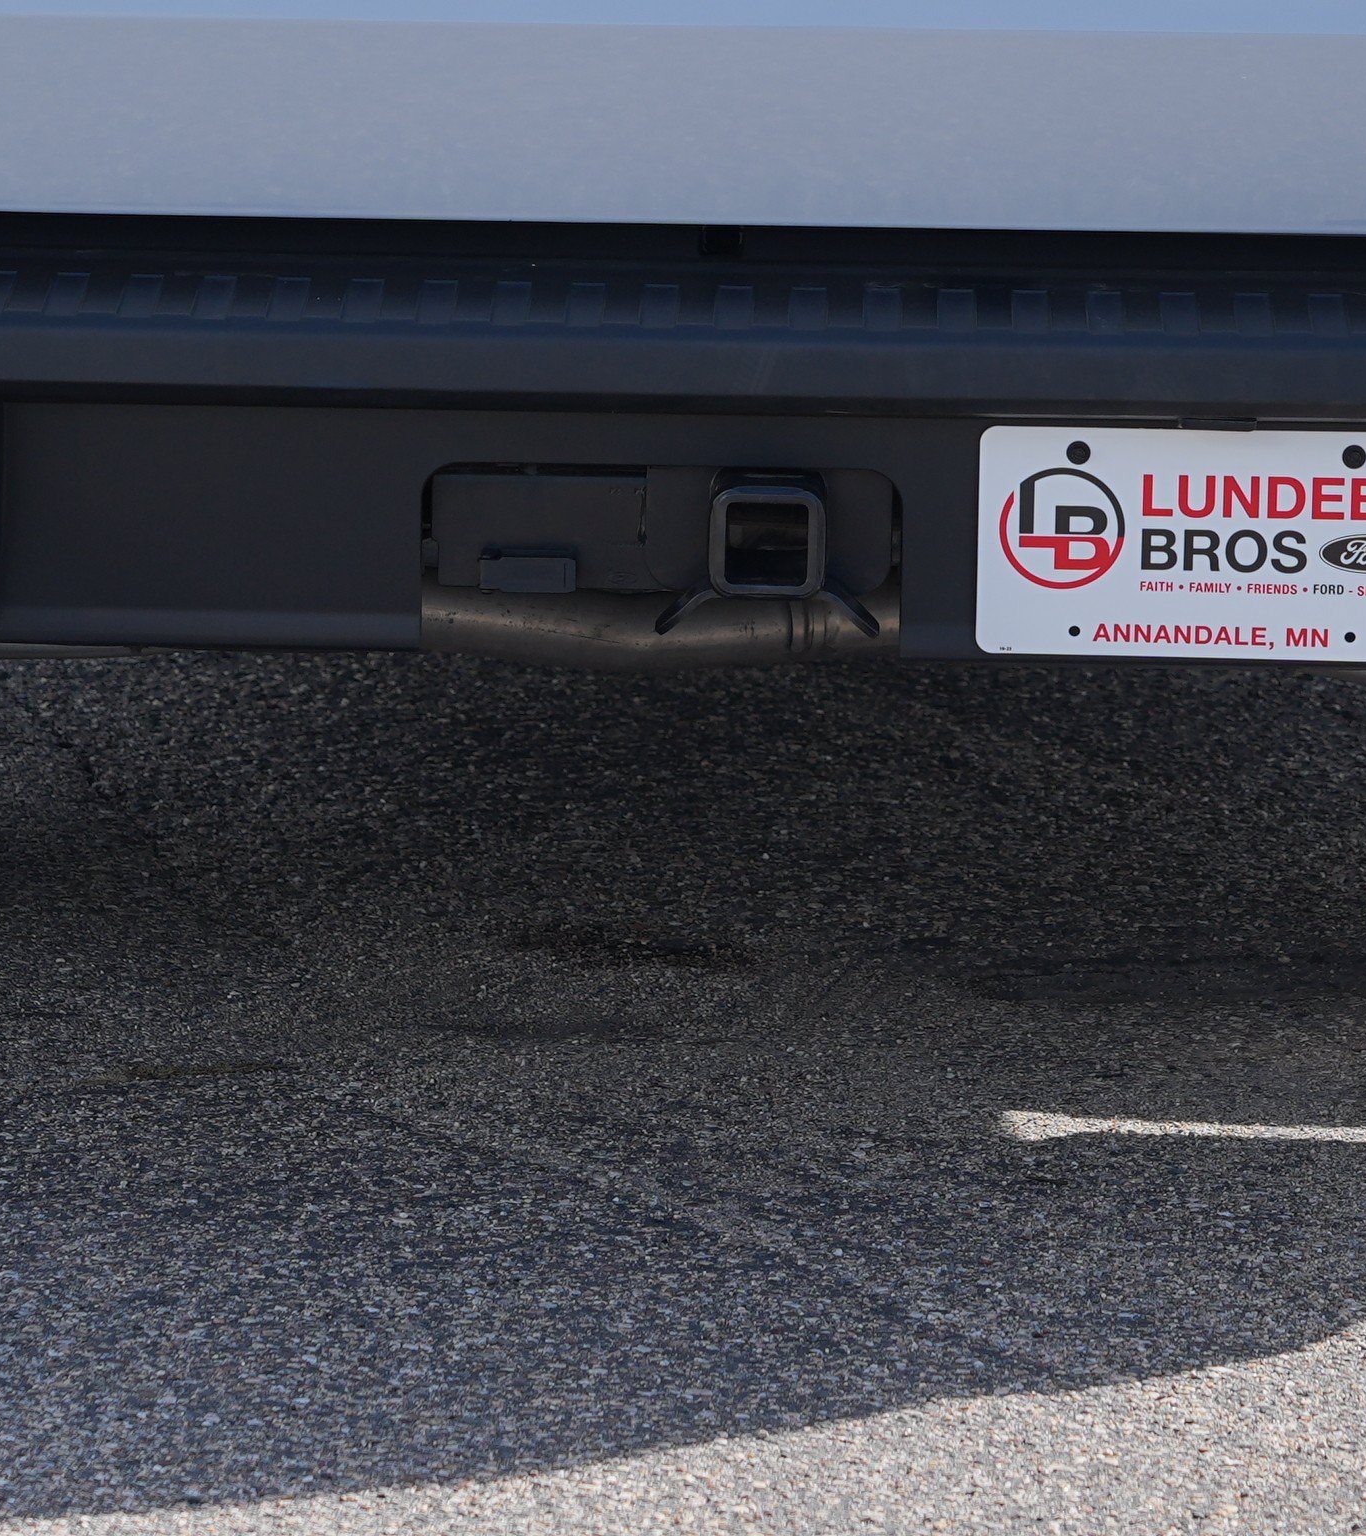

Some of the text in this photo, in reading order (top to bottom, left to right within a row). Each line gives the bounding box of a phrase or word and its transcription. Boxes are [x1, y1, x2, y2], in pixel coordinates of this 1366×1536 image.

[1140, 528, 1308, 575] BROS
[1139, 580, 1175, 593] FAITH
[1188, 581, 1232, 595] FAMILY
[1246, 583, 1299, 595] FRIENDS
[1312, 584, 1345, 596] FORD
[1091, 622, 1330, 650] ANNANDALE, MN
